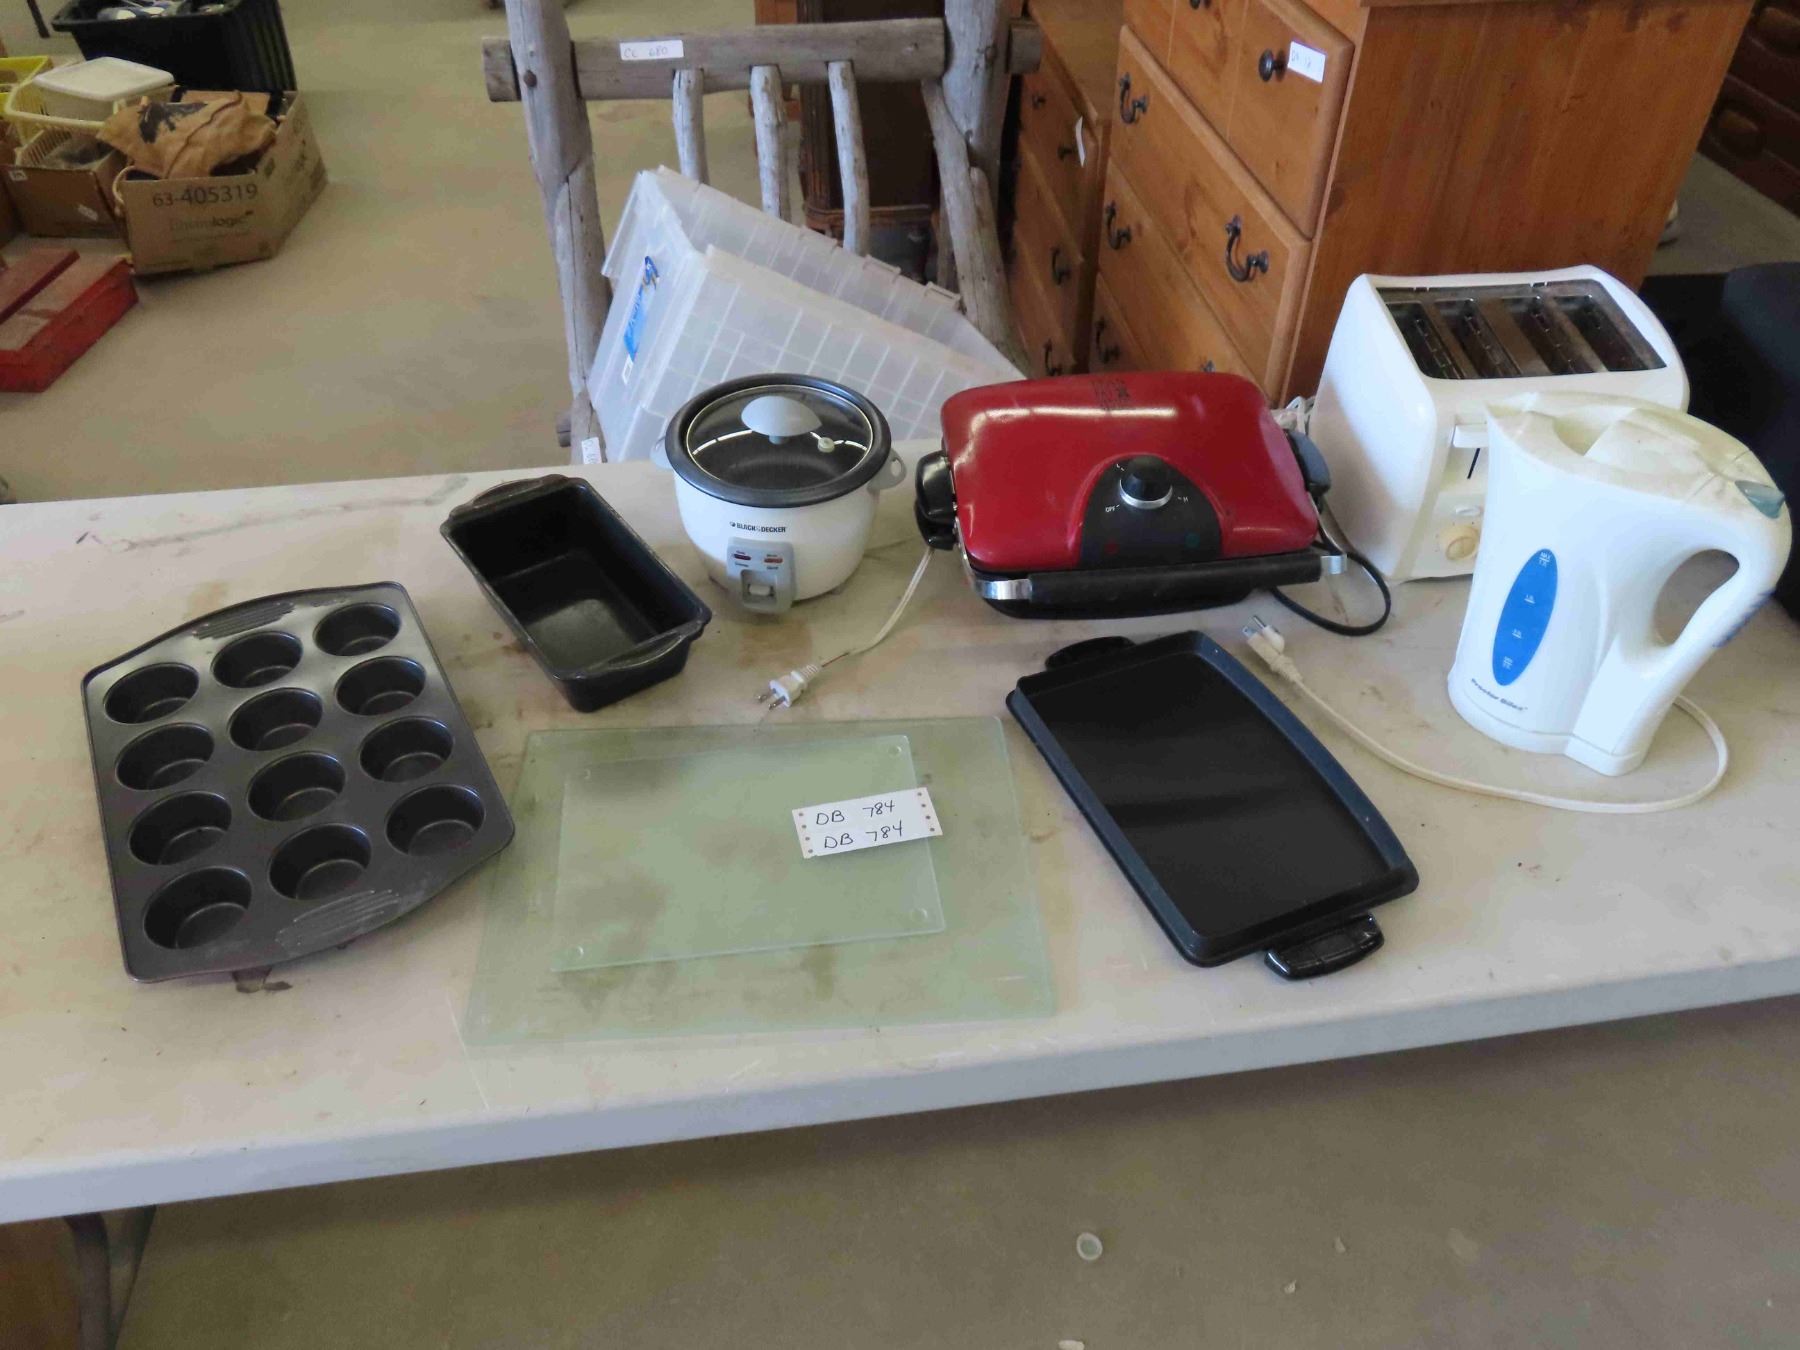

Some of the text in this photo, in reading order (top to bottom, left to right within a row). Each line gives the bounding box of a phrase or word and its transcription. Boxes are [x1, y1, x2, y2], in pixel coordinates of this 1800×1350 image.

[152, 182, 258, 207] 63-405319
[816, 799, 895, 826] DB 784
[824, 819, 903, 849] DB 784
